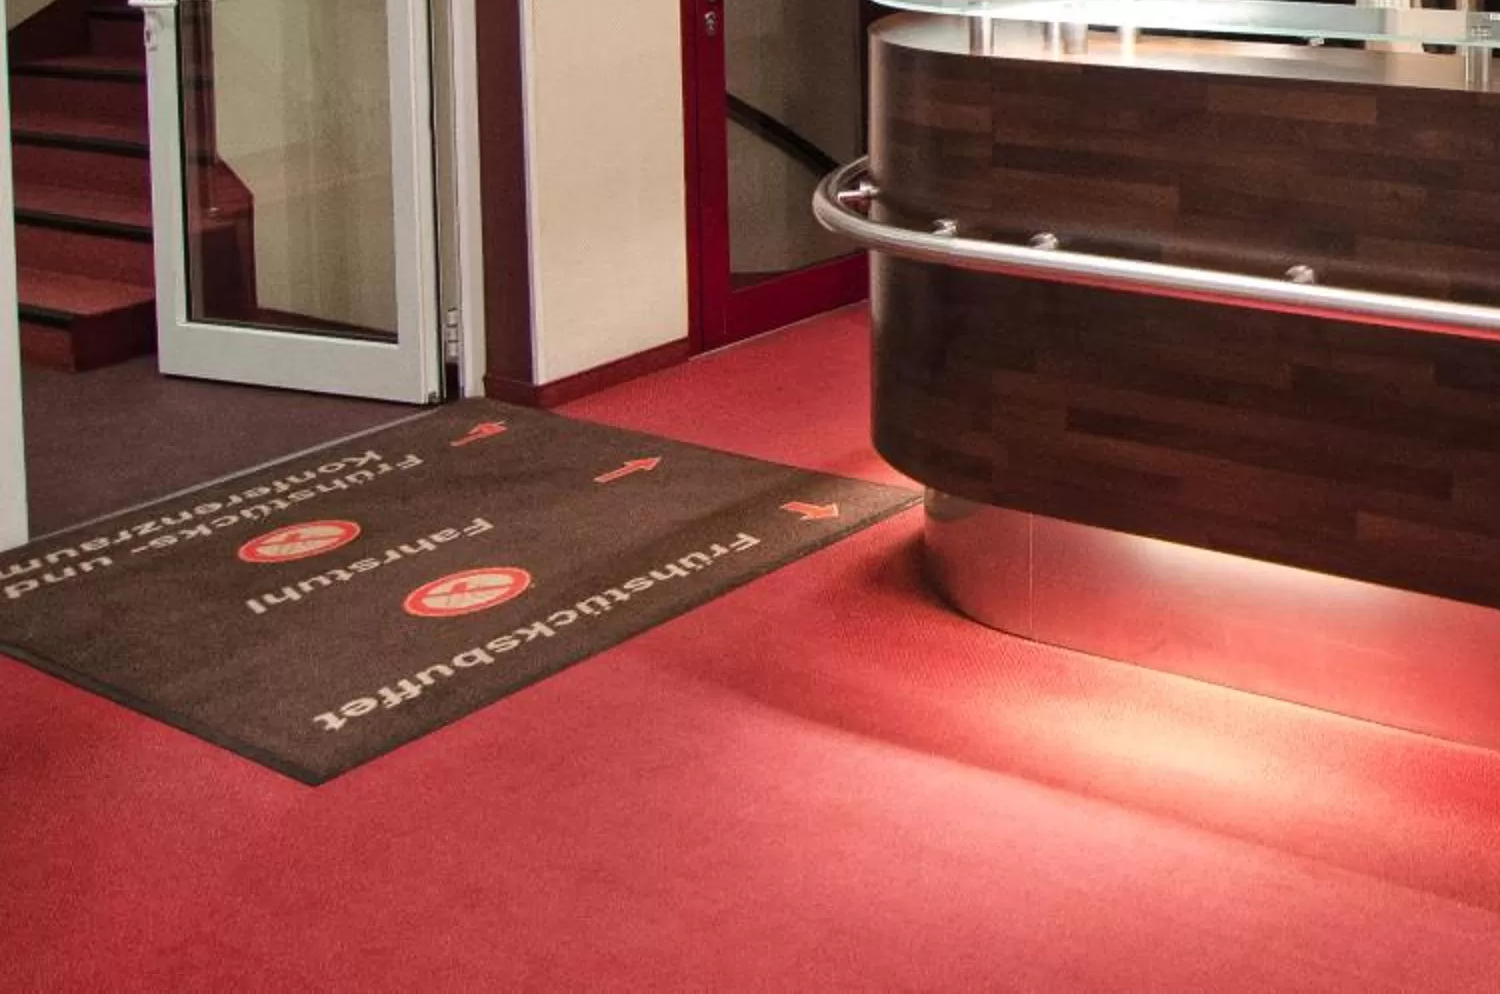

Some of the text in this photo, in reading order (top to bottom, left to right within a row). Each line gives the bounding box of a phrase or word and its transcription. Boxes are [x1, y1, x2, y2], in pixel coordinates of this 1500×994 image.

[2, 454, 424, 599] Frühstücks- und
[245, 517, 495, 615] Fahrstuhl
[313, 532, 761, 732] Frühstücksbuffet
